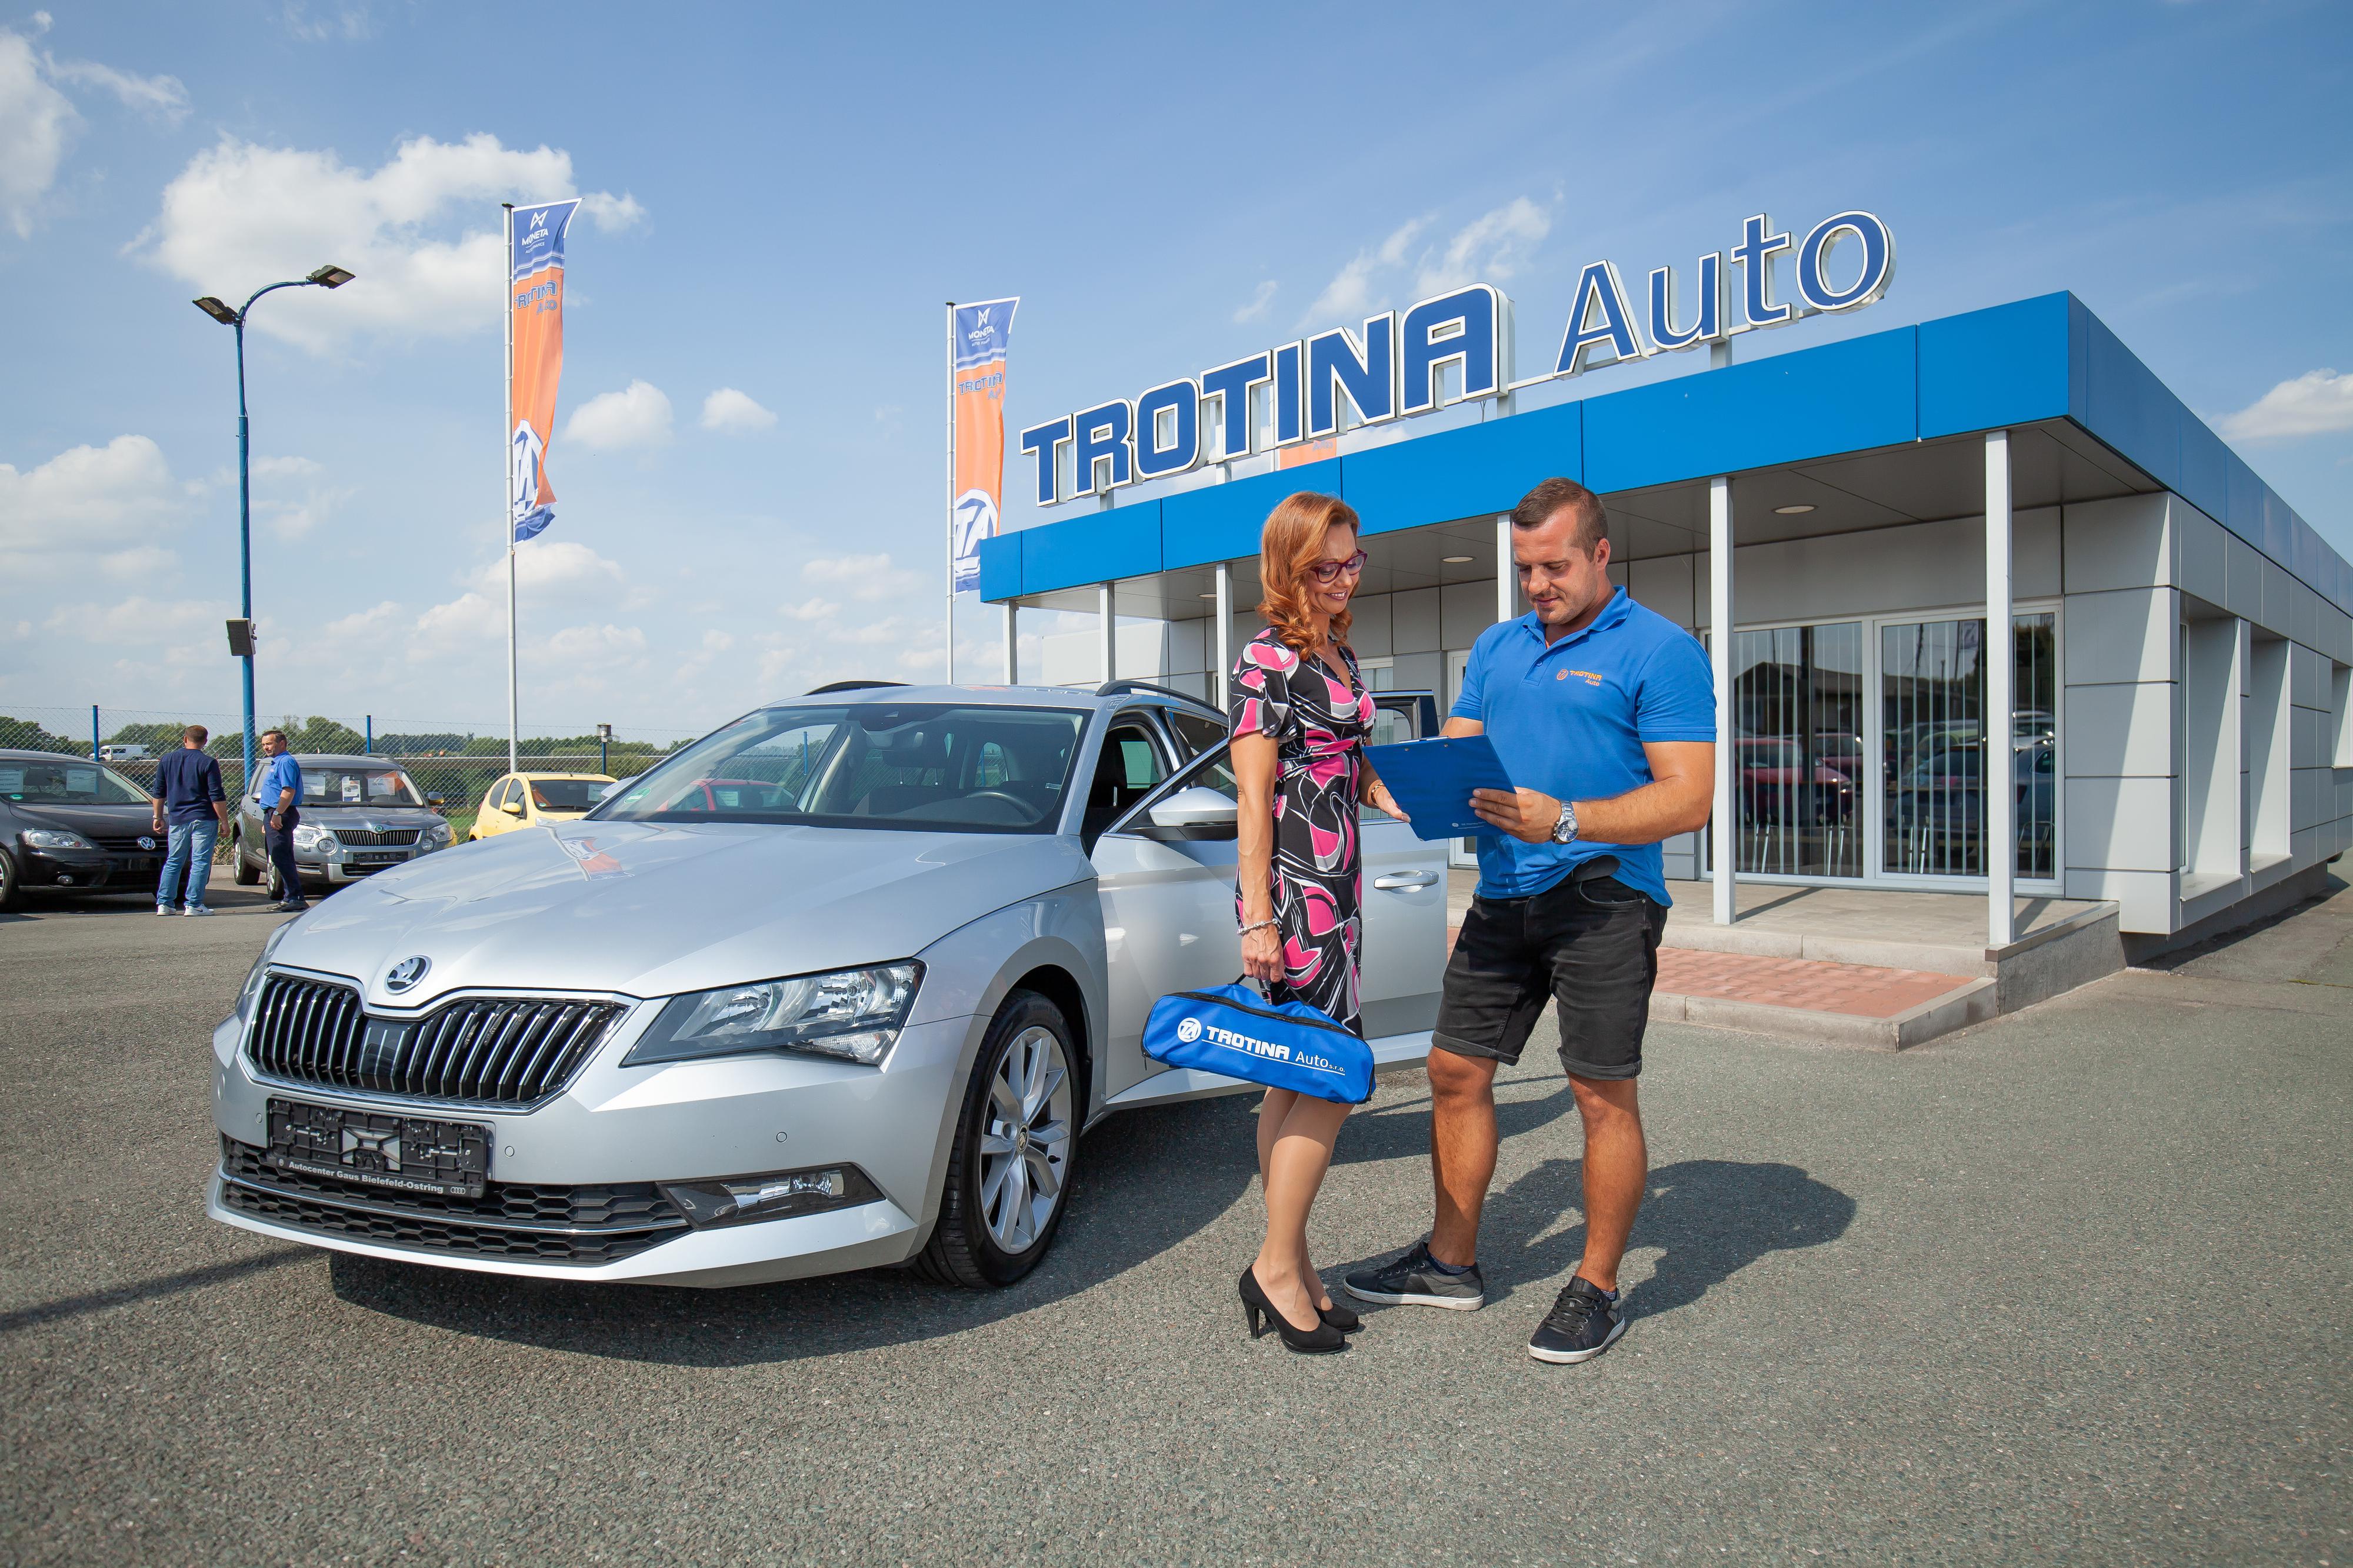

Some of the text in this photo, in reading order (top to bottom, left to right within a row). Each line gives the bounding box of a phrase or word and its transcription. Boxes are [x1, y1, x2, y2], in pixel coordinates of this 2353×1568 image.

[522, 228, 548, 246] MONETA
[968, 325, 995, 340] MONETA
[1020, 209, 1891, 507] TROTINA Auto
[1585, 678, 1600, 686] Auto
[1206, 1025, 1291, 1060] TROTINA
[1295, 1051, 1329, 1068] Auto
[1329, 1063, 1345, 1072] s.r.o.
[289, 1161, 444, 1194] Autocenter Gaus Bielefeld-Ostring
